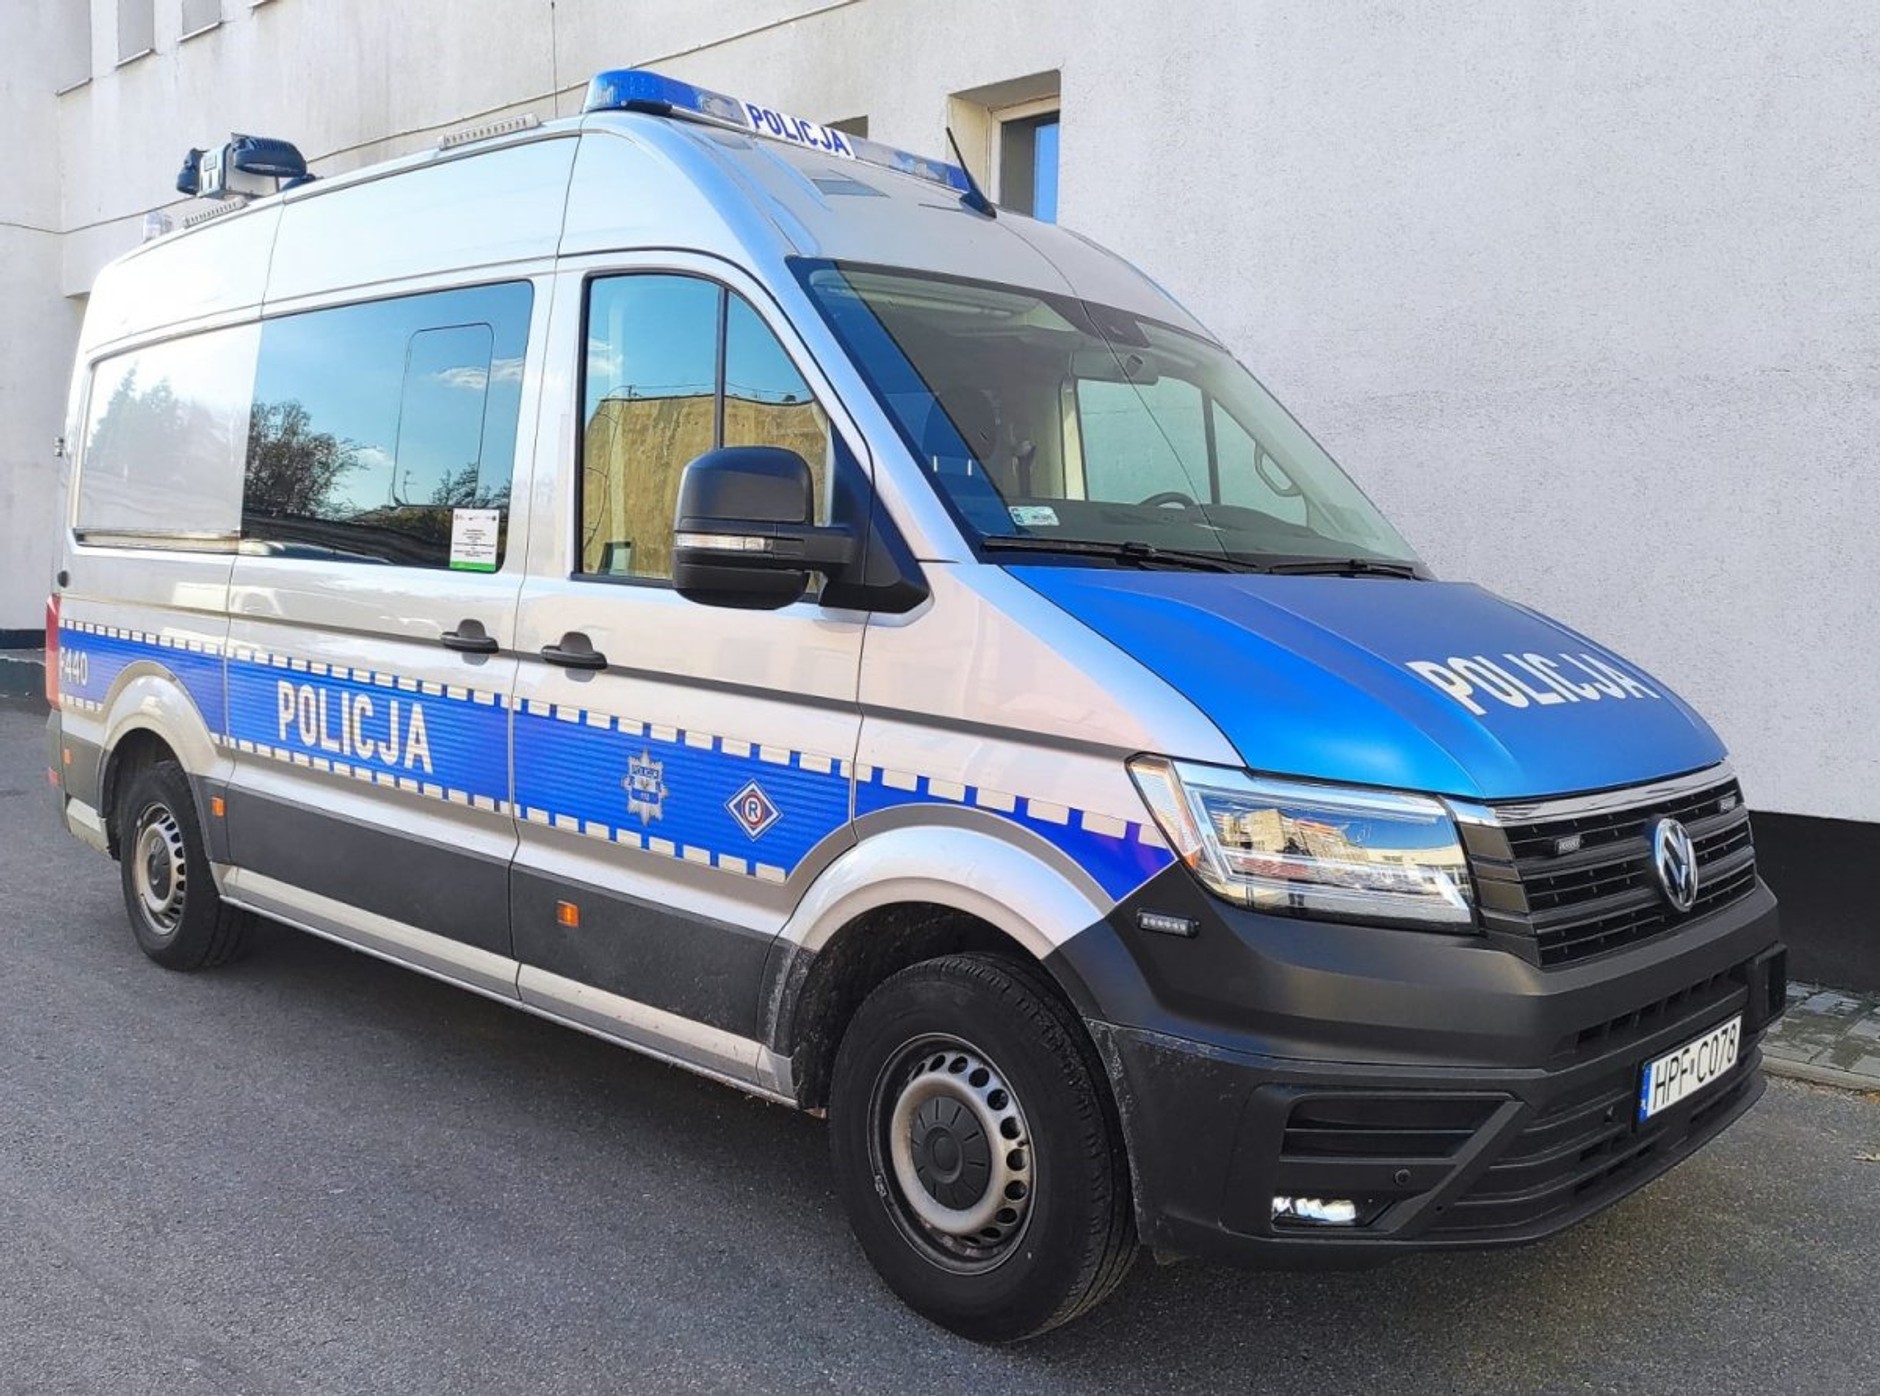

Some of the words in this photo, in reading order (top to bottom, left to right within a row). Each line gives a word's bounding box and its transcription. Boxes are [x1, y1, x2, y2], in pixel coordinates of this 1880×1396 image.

[745, 103, 851, 156] POLICJA
[1404, 653, 1661, 716] POLICJA
[277, 680, 434, 775] POLICJA
[748, 800, 758, 819] R
[1652, 1047, 1690, 1111] HPF
[1696, 1023, 1737, 1084] C078
